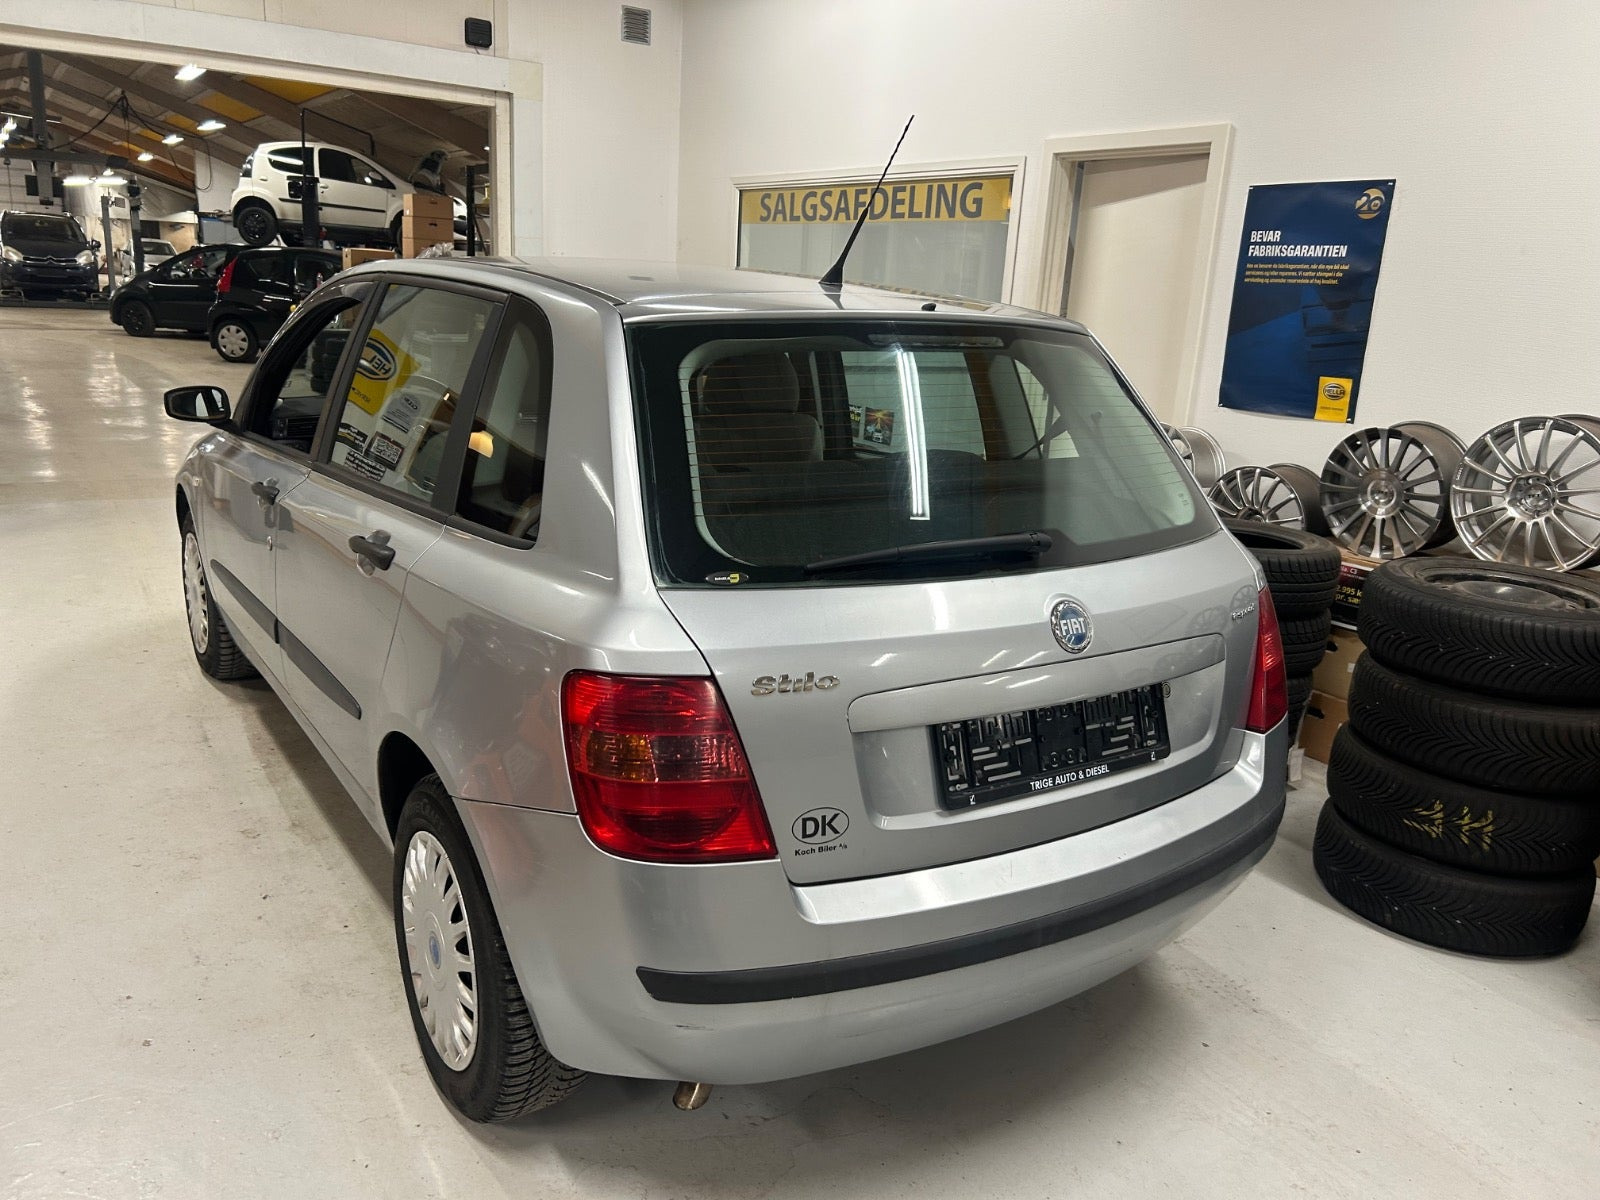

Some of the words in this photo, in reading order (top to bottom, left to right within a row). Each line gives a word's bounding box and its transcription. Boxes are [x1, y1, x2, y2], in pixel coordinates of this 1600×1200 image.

[759, 182, 984, 222] SALGSAFDELING
[1250, 230, 1281, 243] BEVAR
[1248, 245, 1347, 258] FABRIKSGARANTIEN
[1060, 617, 1086, 636] FIAT
[751, 671, 841, 696] Stilo
[1030, 777, 1054, 791] TRIGE
[1055, 772, 1077, 785] AUTO
[1078, 770, 1085, 780] &
[1085, 764, 1110, 778] DIESEL
[801, 812, 841, 839] DK
[794, 847, 816, 856] Koch
[817, 845, 837, 853] Biler
